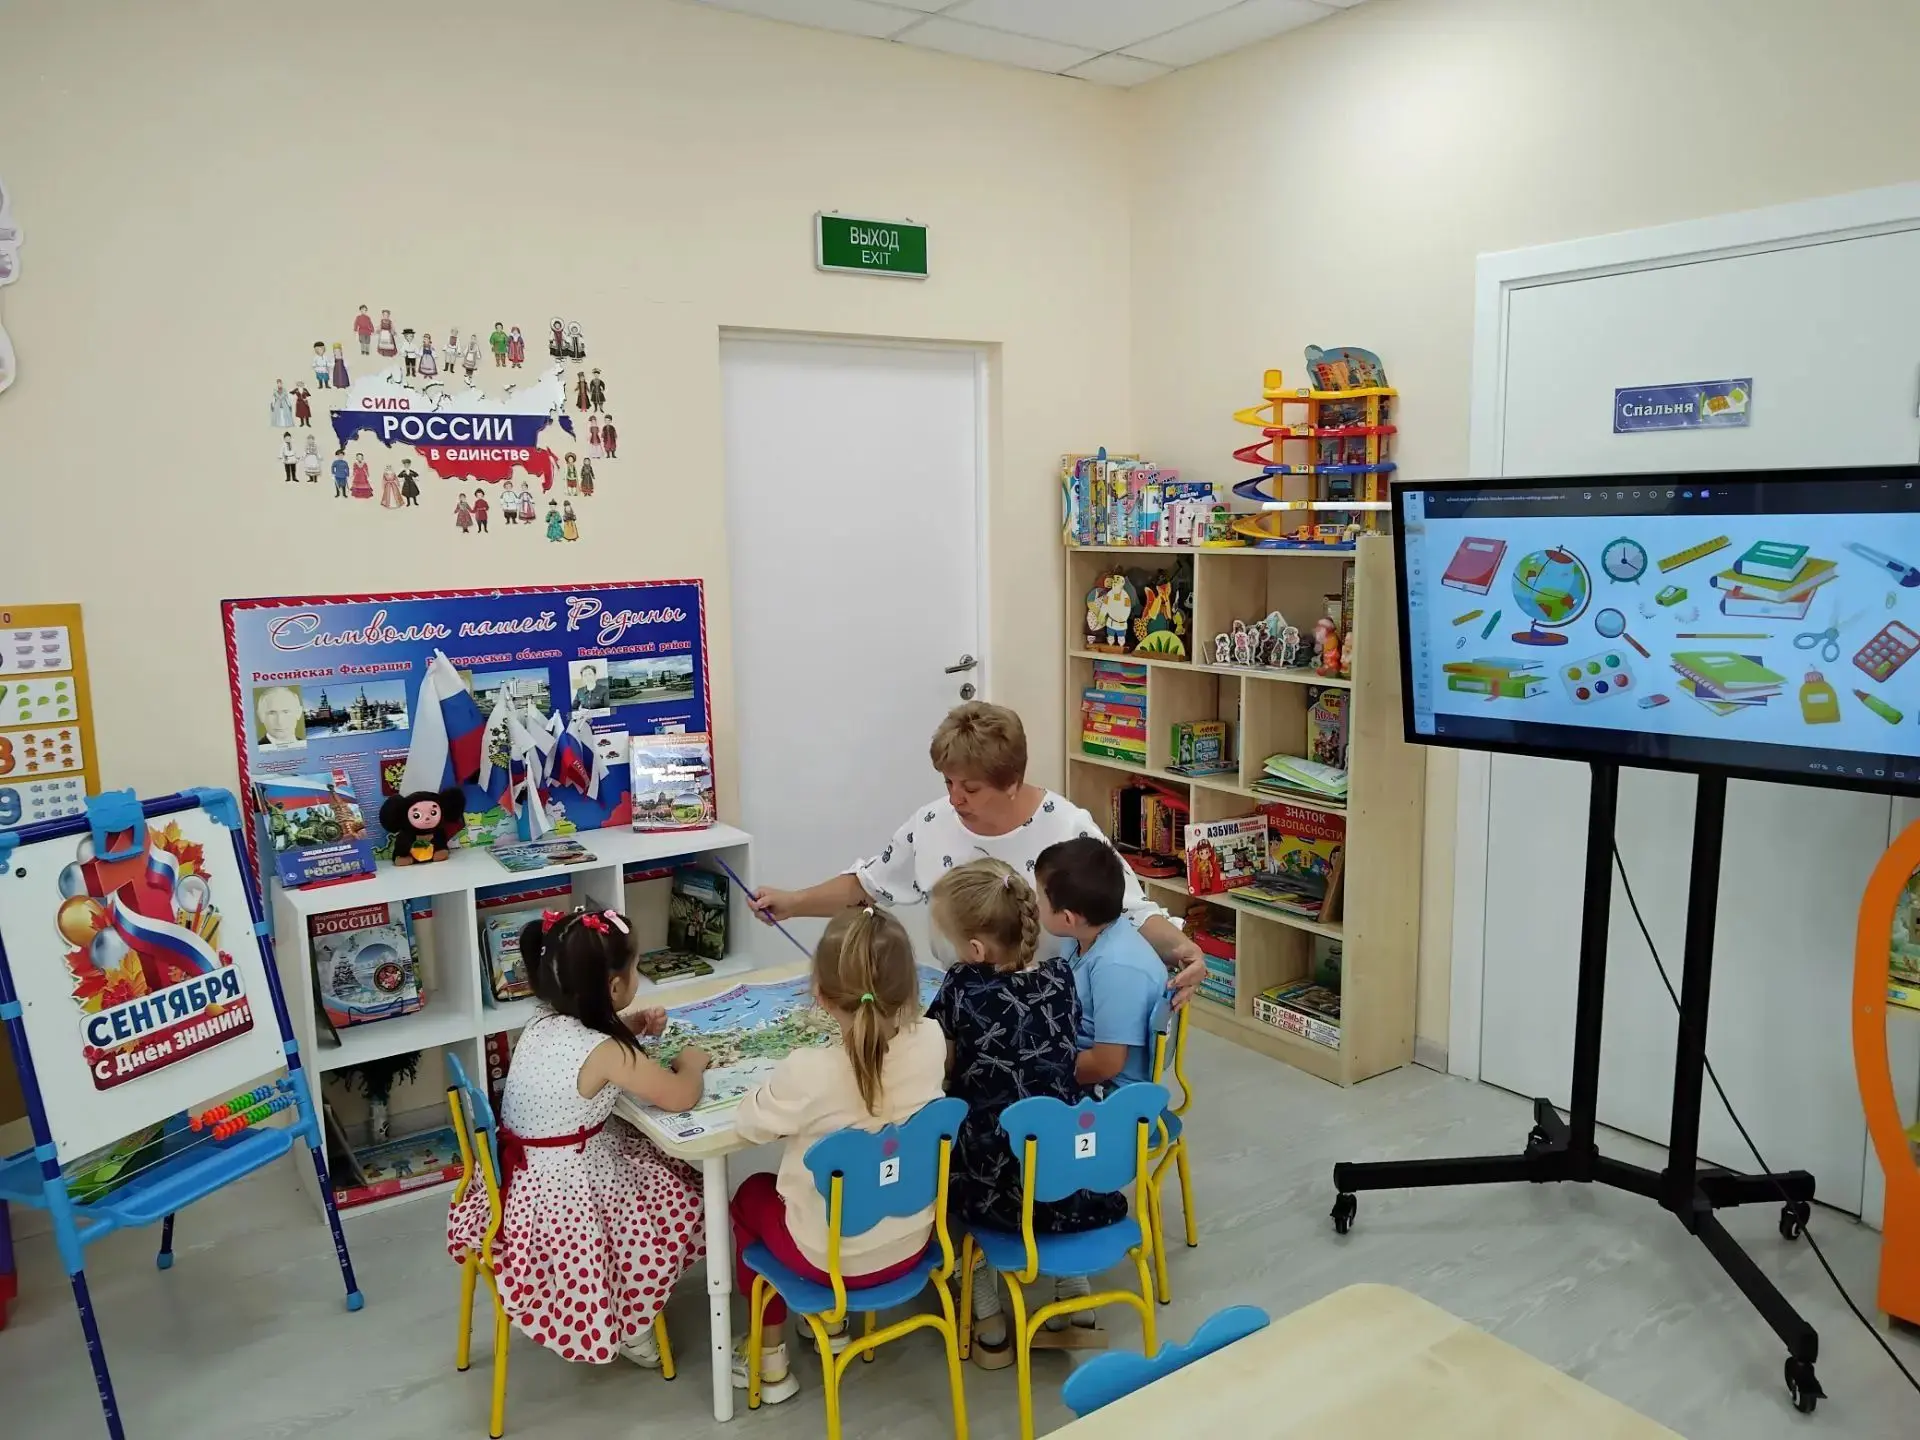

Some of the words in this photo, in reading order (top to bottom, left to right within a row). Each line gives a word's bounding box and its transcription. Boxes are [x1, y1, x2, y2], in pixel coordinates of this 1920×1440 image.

[850, 226, 899, 252] ВЫХОД
[861, 250, 891, 264] EXIT
[1622, 402, 1694, 417] Спальня
[383, 415, 513, 441] РОССИИ
[267, 608, 452, 651] Символы
[458, 611, 557, 638] нашей
[565, 596, 687, 646] Родины
[425, 653, 512, 667] Бгородская
[516, 649, 563, 661] область
[577, 642, 655, 657] Вейделевский
[659, 640, 692, 652] район
[252, 667, 333, 682] Российская
[339, 660, 412, 675] Федерация
[1285, 806, 1326, 824] ЗНАТОК
[1206, 823, 1240, 839] АЗБУКА
[1269, 815, 1344, 841] БЕЗОПАСНОСТИ
[317, 856, 342, 866] МОЯ
[316, 912, 384, 934] РОССИИ
[87, 968, 240, 1048] СЕНТЯБРЯ
[1271, 1006, 1278, 1015] О
[1278, 1009, 1305, 1025] СЕМЬЕ
[1271, 1015, 1278, 1024] О
[1277, 1018, 1304, 1035] СЕМЬЕ
[115, 1039, 173, 1076] Днём
[172, 1004, 251, 1050] ЗНАНИЙ!
[1080, 1138, 1089, 1152] 2
[885, 1164, 893, 1179] 2
